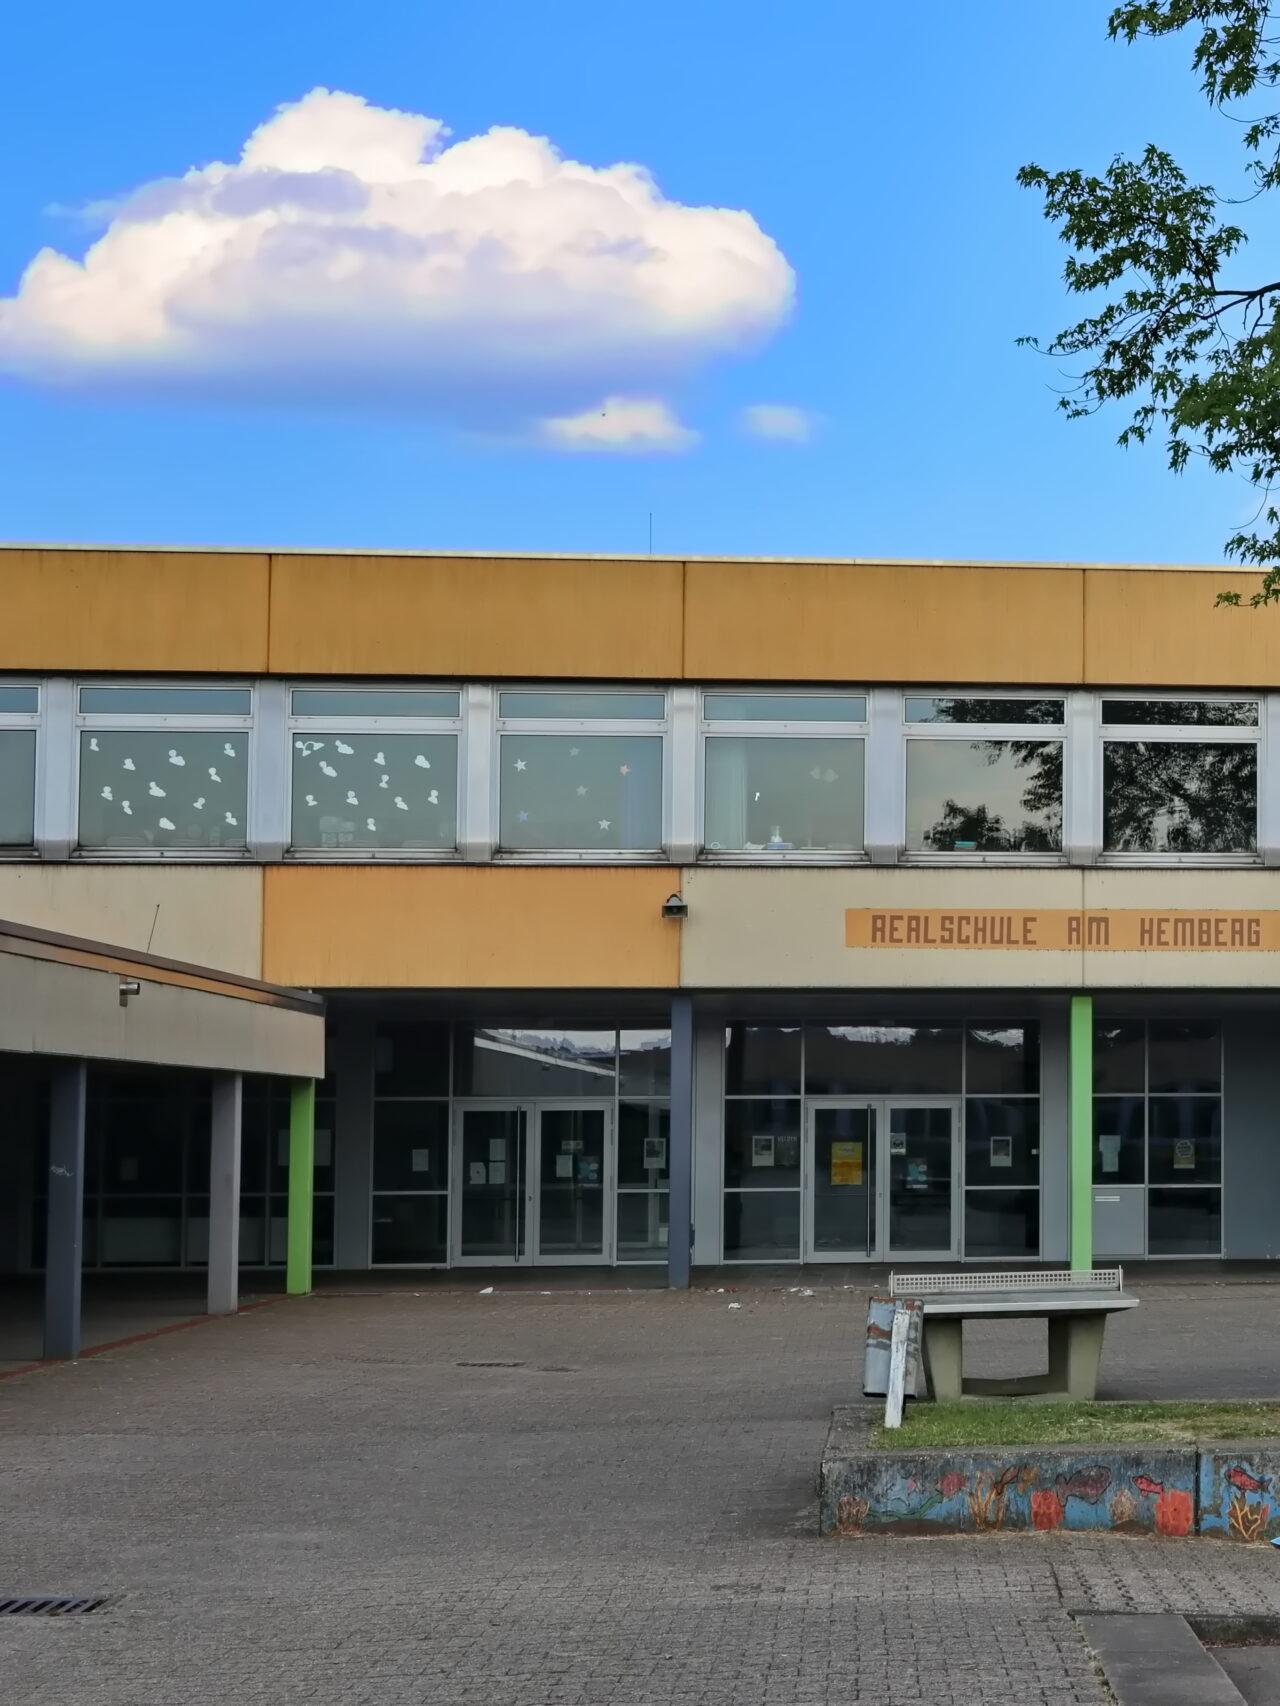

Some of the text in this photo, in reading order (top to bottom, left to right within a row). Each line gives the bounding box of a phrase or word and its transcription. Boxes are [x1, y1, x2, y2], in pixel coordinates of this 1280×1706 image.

[872, 914, 1260, 946] REALSCHULE AM HEMBERG
